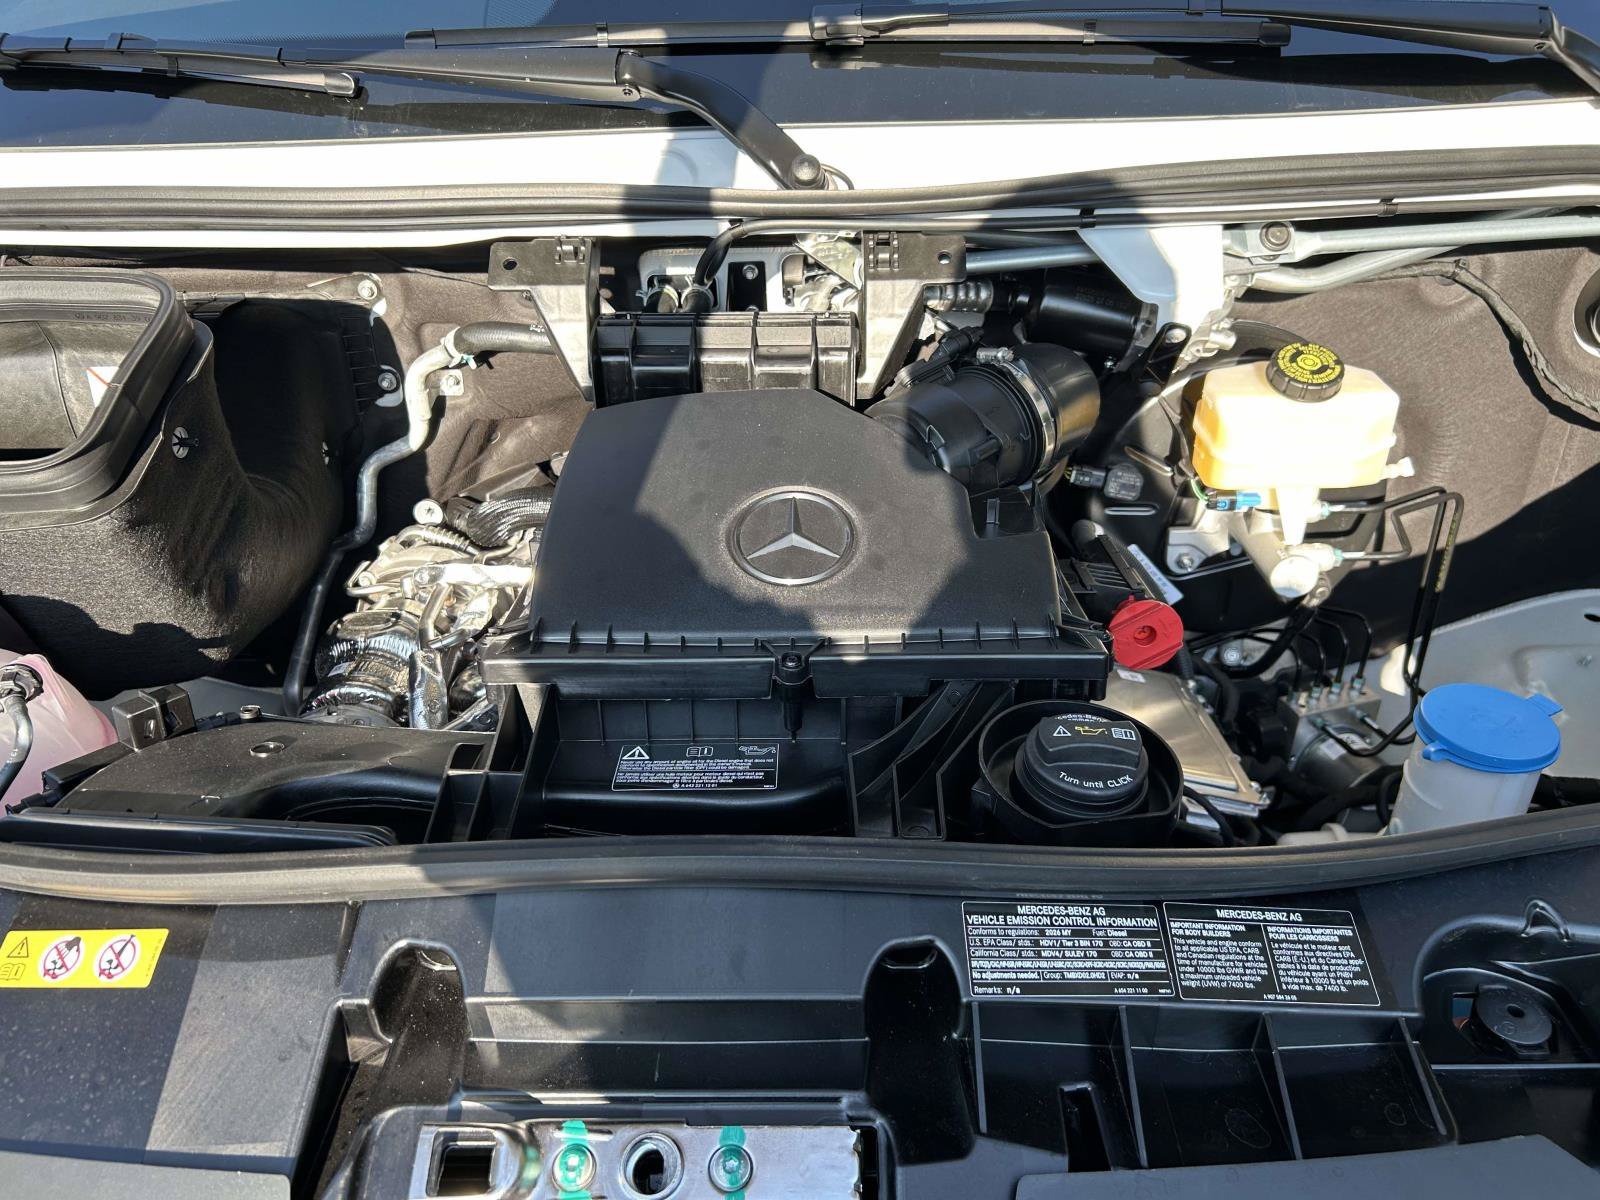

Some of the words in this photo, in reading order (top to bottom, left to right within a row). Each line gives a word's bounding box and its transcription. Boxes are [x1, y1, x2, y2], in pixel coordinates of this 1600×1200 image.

[1060, 772, 1079, 785] Turn
[1107, 775, 1133, 788] CLICK
[1017, 905, 1091, 916] MERCEDES-BENZ
[1093, 907, 1106, 916] AG
[1216, 909, 1288, 921] MERCEDES-BENZ
[1290, 912, 1303, 922] AG
[966, 915, 1005, 925] VEHICLE
[1006, 916, 1050, 926] EMISSION
[1052, 917, 1095, 926] CONTROL
[1096, 918, 1158, 928] INFORMATION
[1171, 922, 1204, 930] IMPORTANT
[1005, 929, 1040, 937] regulations:
[1267, 926, 1310, 934] INFORMATIONS
[1311, 928, 1353, 936] IMPORTANTES
[1300, 934, 1339, 942] CARROSSIERS
[996, 939, 1016, 947] Class/
[1215, 953, 1246, 961] regulations
[982, 972, 1016, 980] adjustments
[1181, 980, 1200, 988] weight
[1006, 986, 1020, 994] n/a
